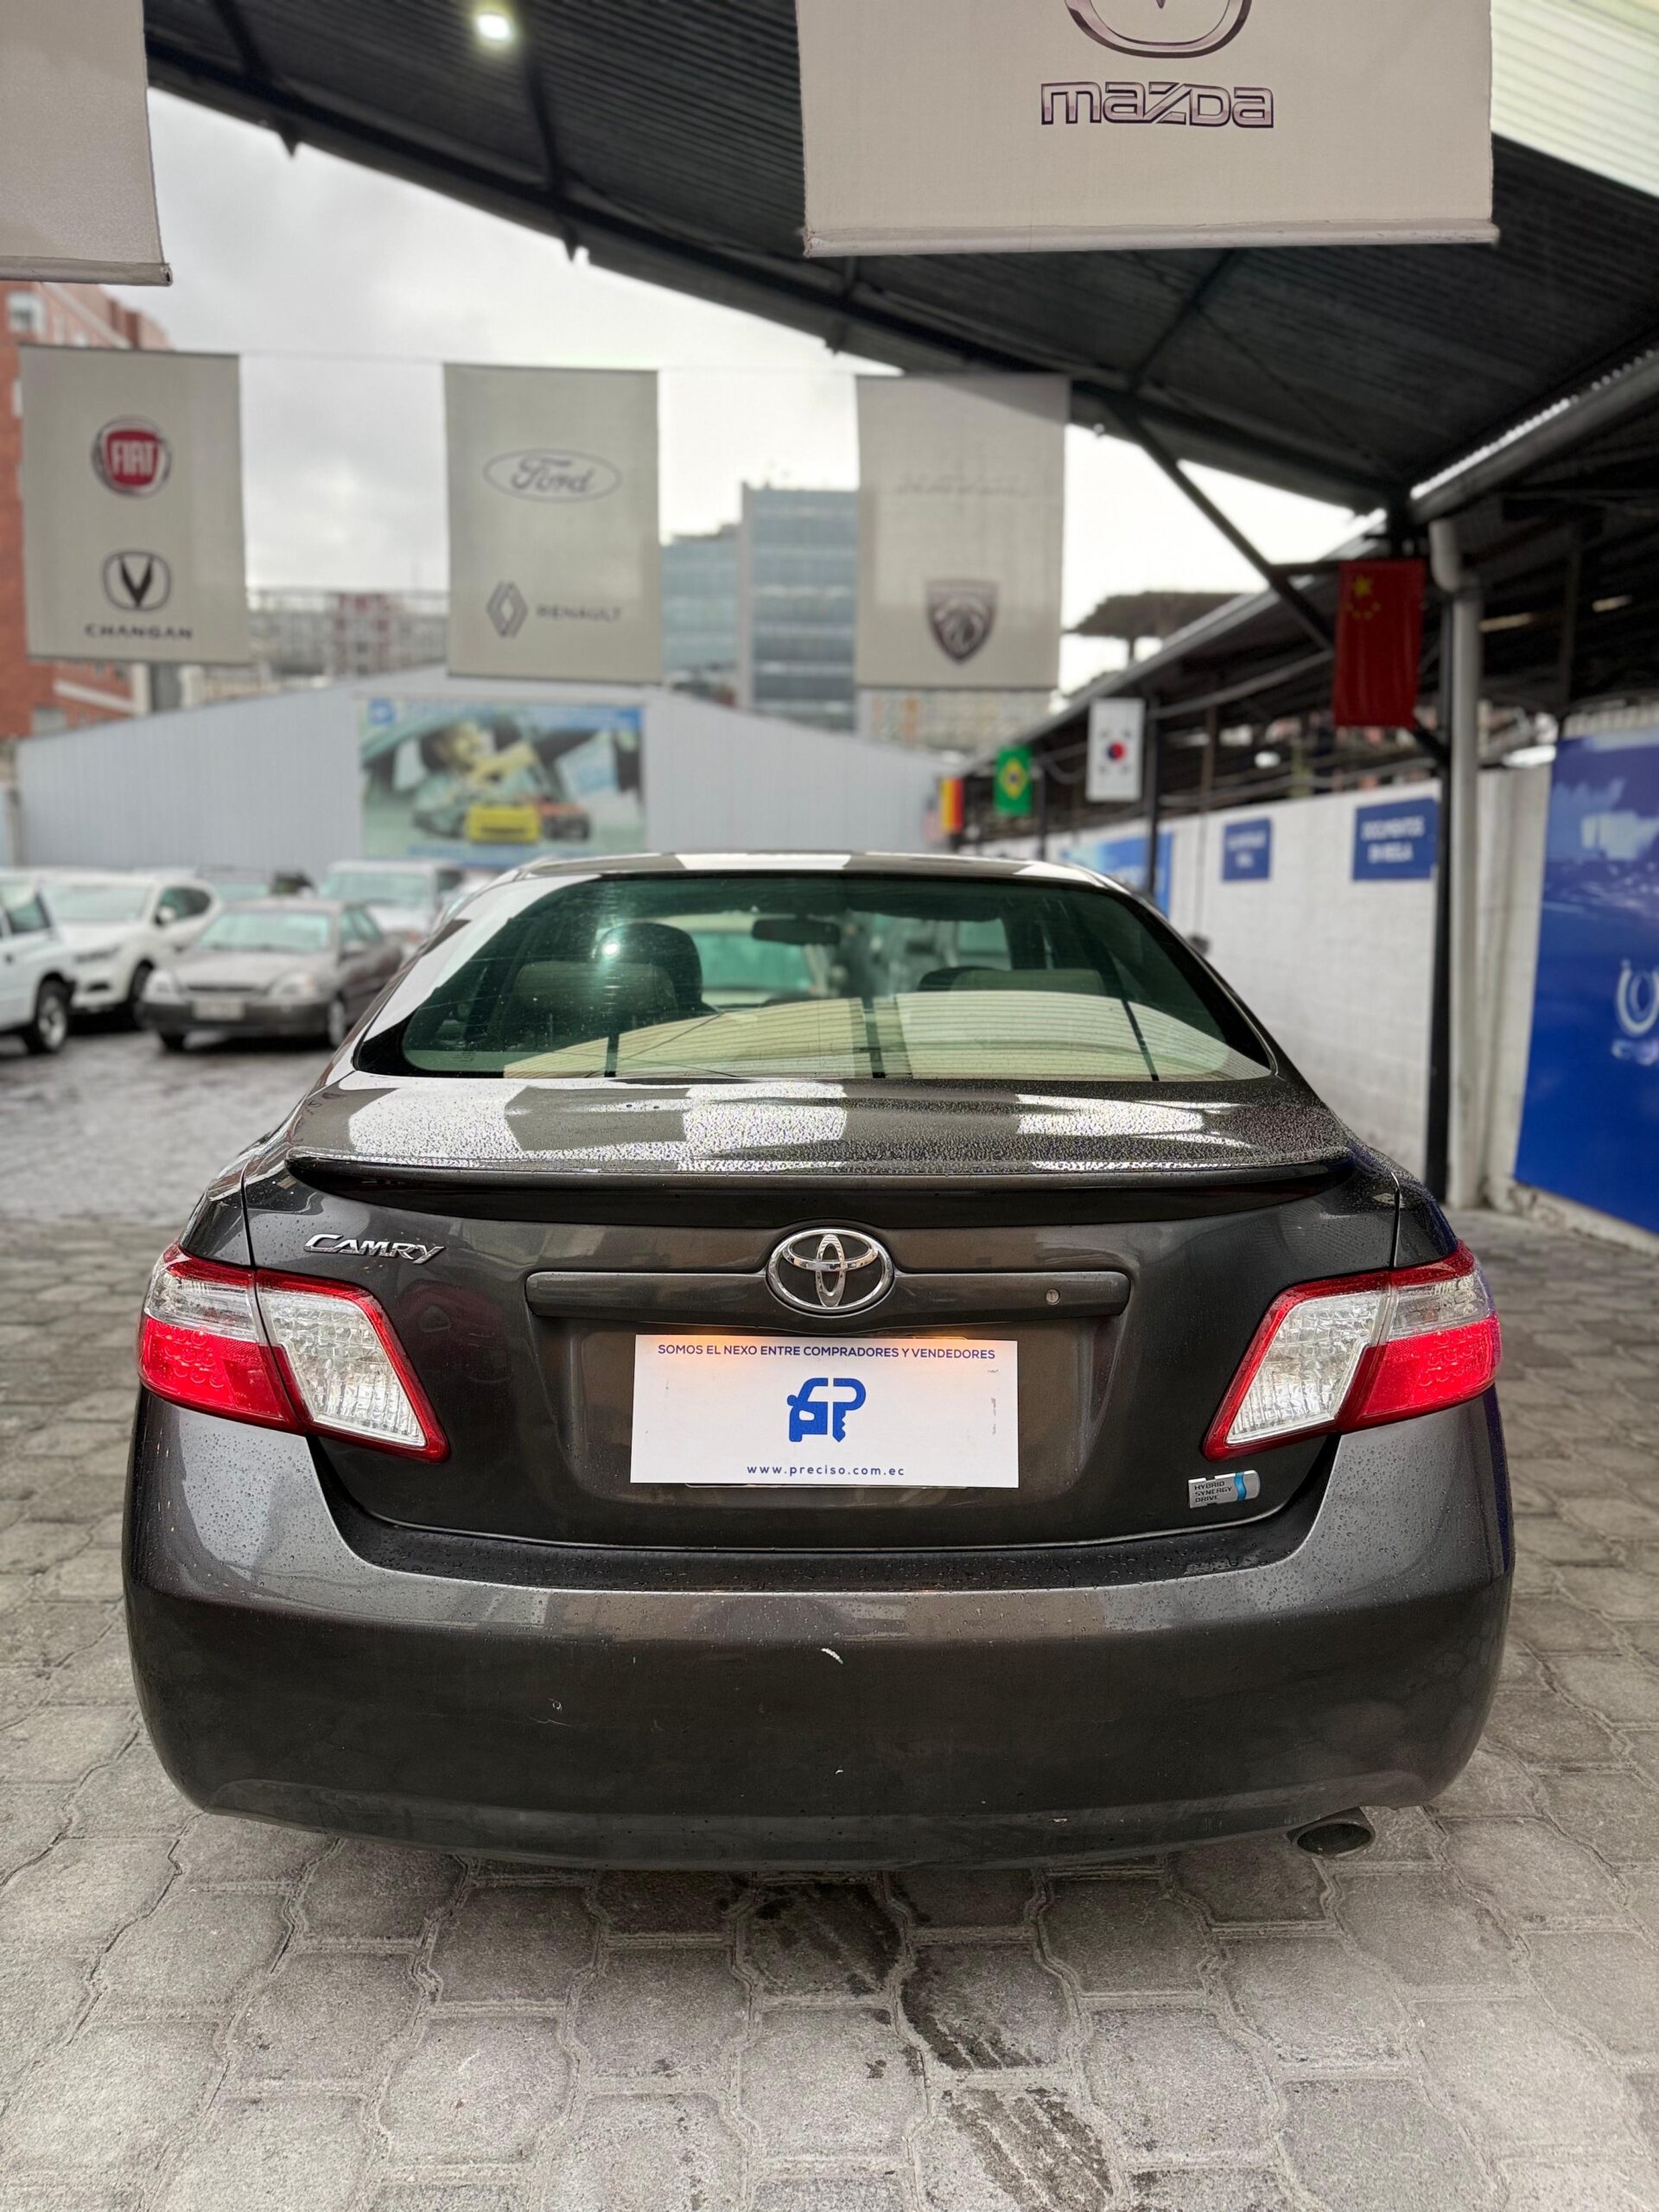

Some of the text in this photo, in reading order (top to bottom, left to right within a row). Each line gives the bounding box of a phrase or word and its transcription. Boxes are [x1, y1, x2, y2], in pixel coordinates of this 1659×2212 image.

[111, 439, 156, 477] FIAT
[511, 456, 595, 493] Ford
[536, 605, 622, 622] RENAULT
[85, 623, 194, 639] CHANGAN
[304, 1233, 446, 1265] CAMRY
[658, 1344, 996, 1359] SOMOS EL NEXO ENTRE COMPRADORES Y VENDEDORES
[747, 1465, 905, 1477] www.preciso.com.ec
[1194, 1480, 1225, 1491] HYBRID
[1194, 1486, 1233, 1497] SYNERGY
[1195, 1494, 1220, 1503] DRIVE
